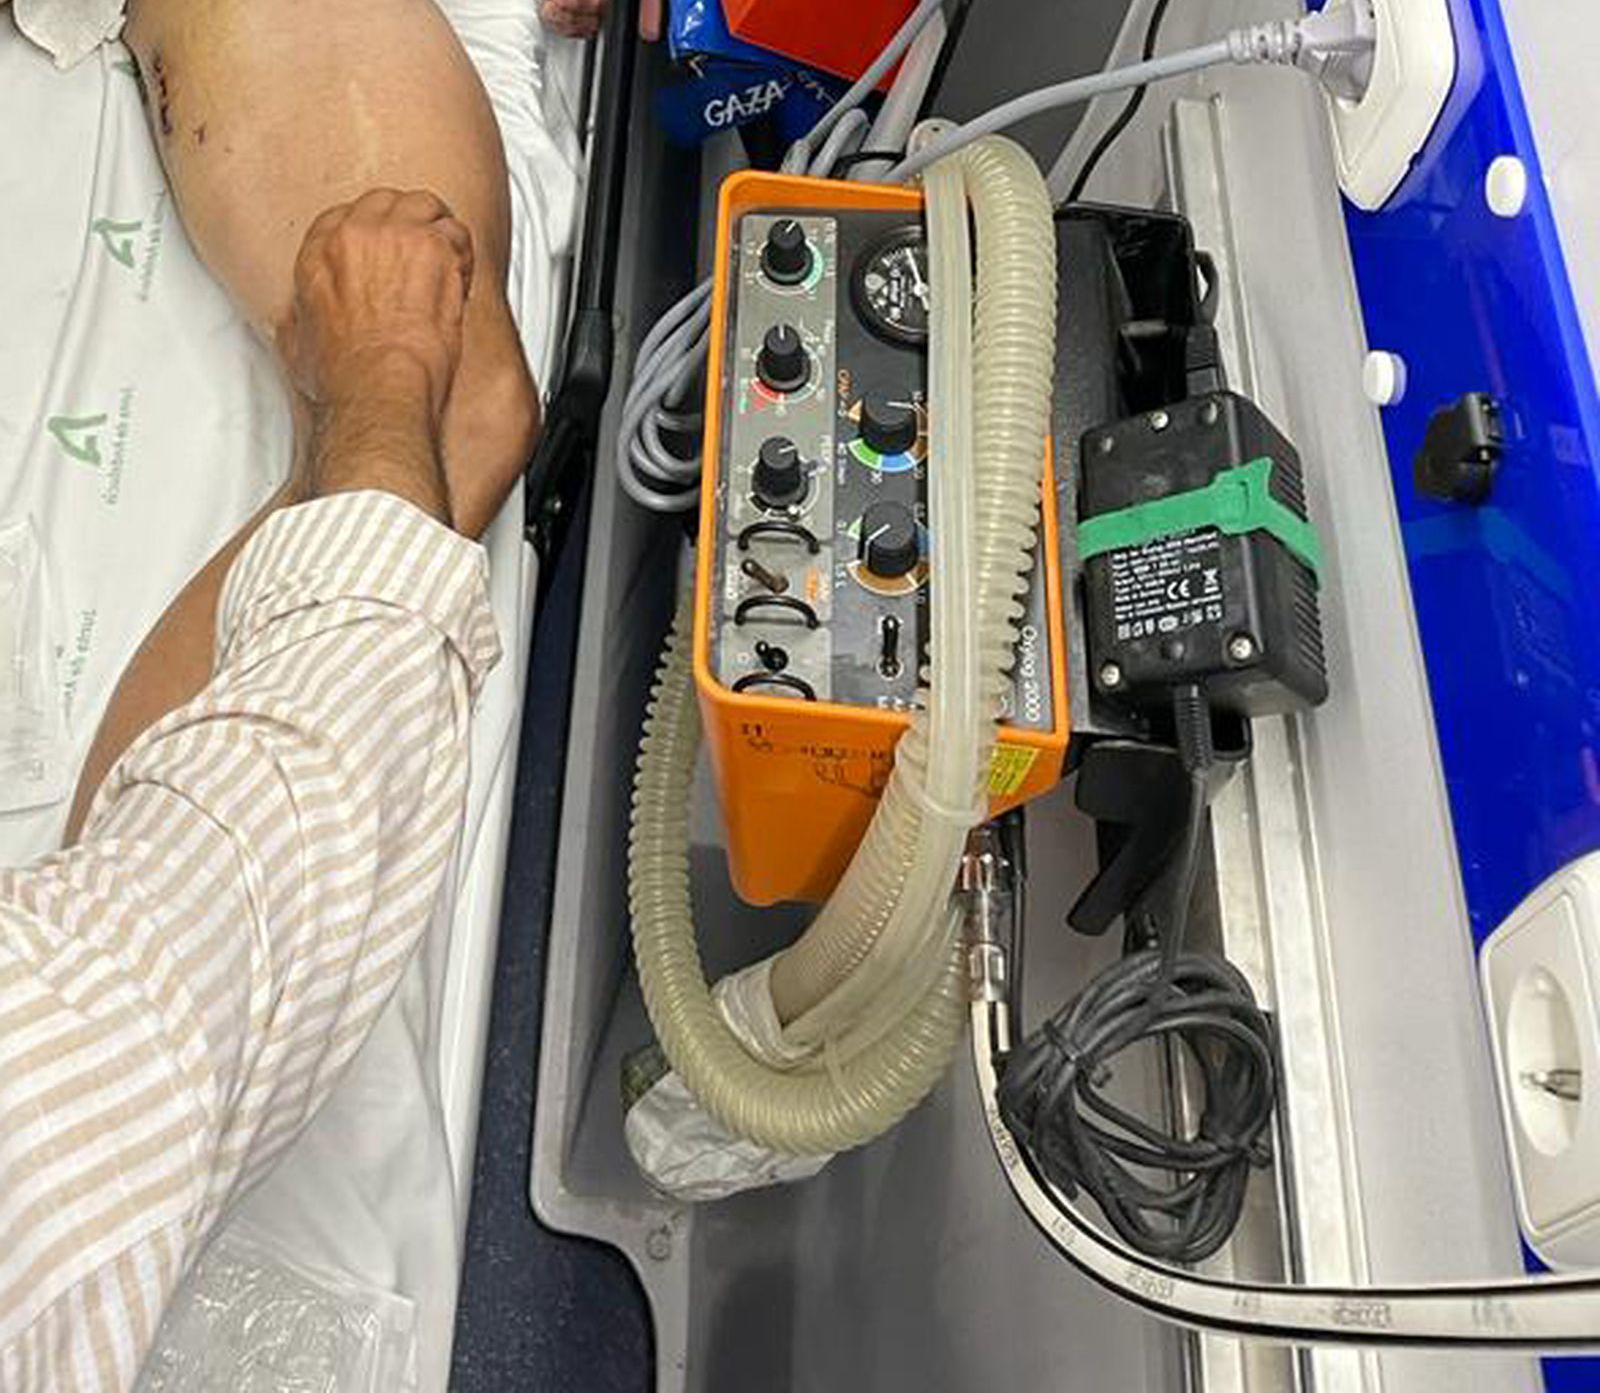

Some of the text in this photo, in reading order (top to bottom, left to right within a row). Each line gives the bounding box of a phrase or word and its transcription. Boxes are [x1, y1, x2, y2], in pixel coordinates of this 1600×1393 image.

[703, 79, 785, 127] GAZA
[1019, 624, 1041, 723] Oxylog 2000
